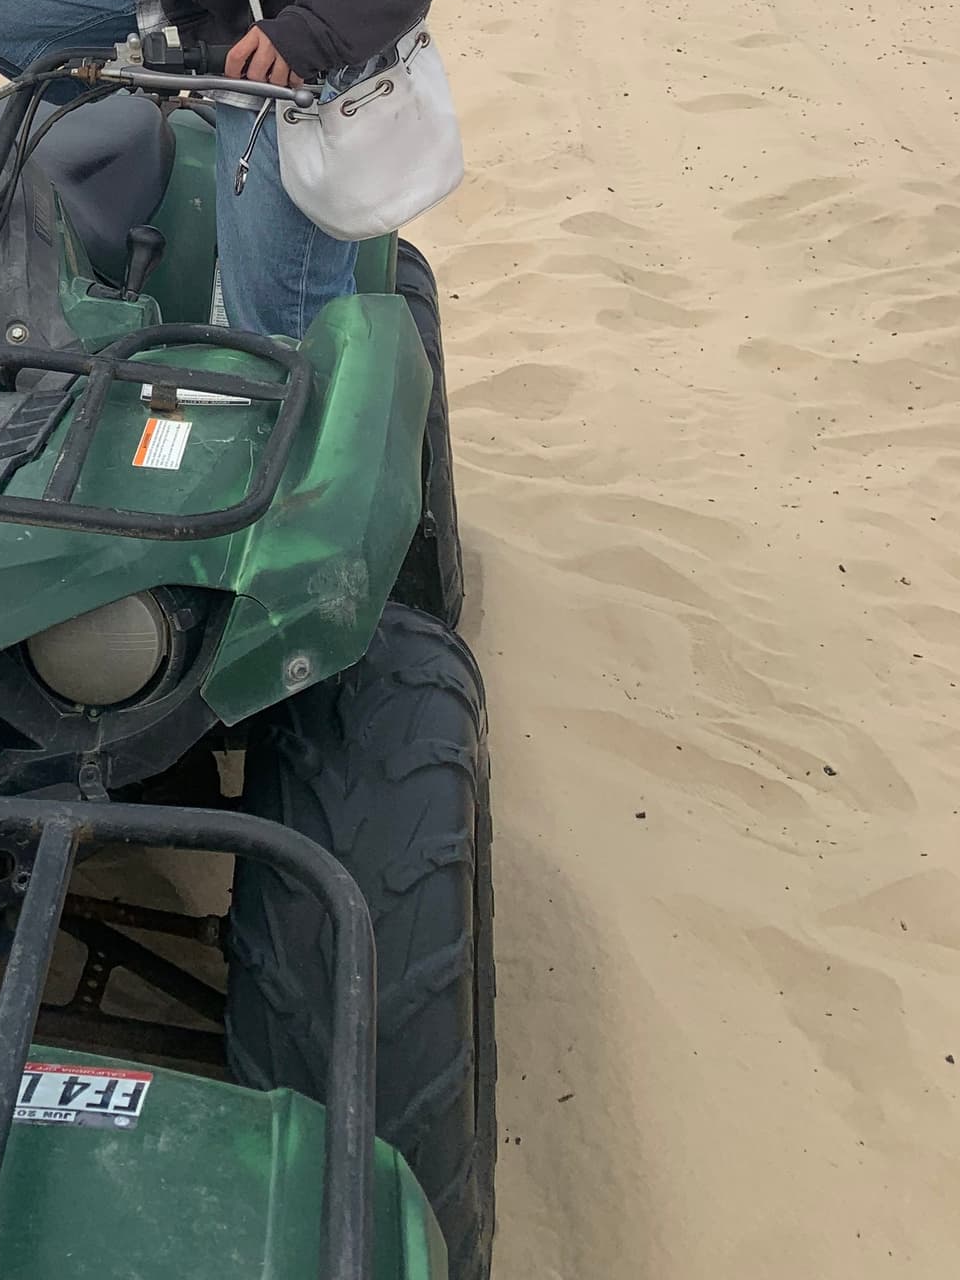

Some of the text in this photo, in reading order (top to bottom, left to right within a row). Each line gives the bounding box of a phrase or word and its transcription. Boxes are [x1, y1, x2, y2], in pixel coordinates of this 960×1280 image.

[58, 1075, 146, 1112] FF4
[13, 1109, 73, 1120] JUN 20
